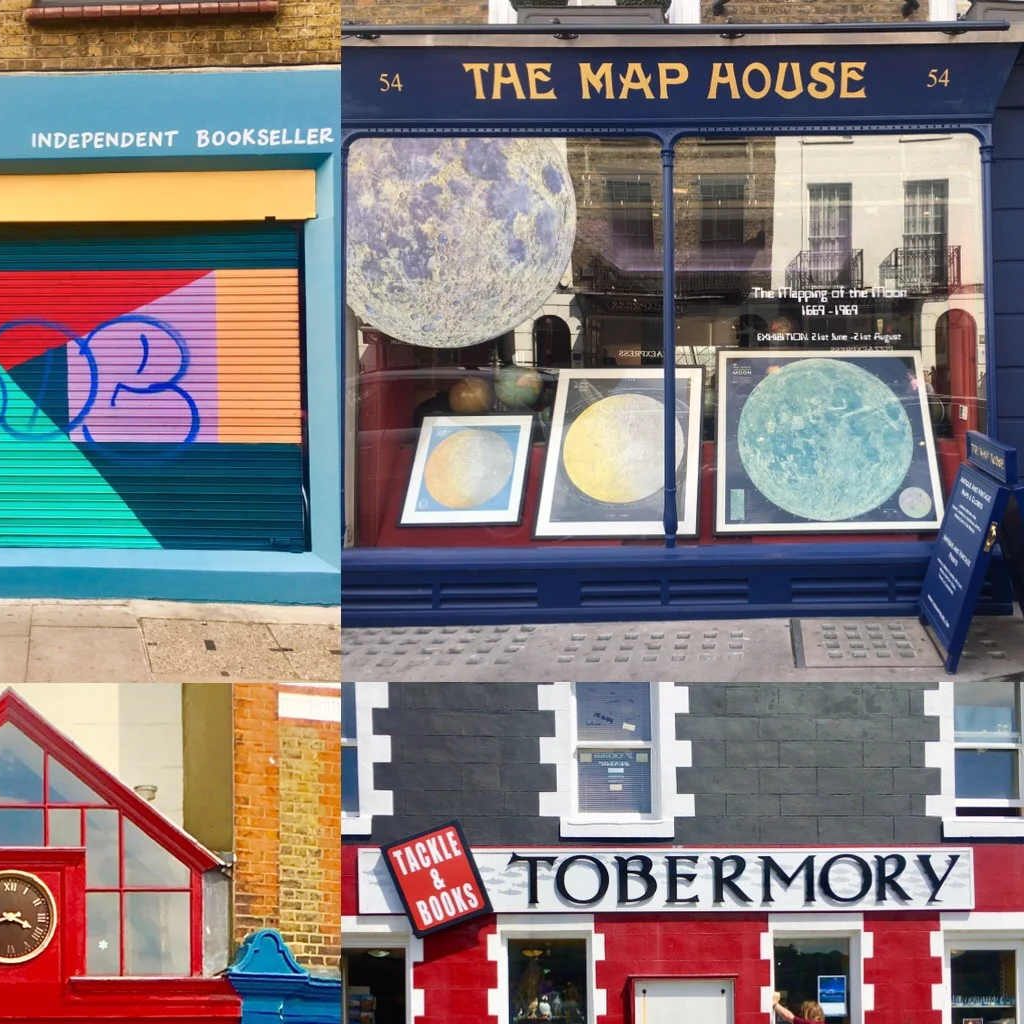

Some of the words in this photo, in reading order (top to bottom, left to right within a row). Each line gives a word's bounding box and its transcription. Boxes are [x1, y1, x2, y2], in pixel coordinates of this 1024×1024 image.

[379, 73, 403, 92] 54
[462, 62, 558, 100] THE
[578, 62, 689, 100] MAP
[707, 61, 867, 100] HOUSE
[927, 68, 950, 88] 54
[31, 130, 179, 149] INDEPENDENT
[196, 127, 335, 147] BOOKSELLER
[751, 287, 775, 299] The
[778, 287, 828, 303] Mapping
[831, 288, 845, 299] of
[849, 287, 869, 299] the
[871, 287, 908, 299] Moon
[801, 304, 825, 316] 1669
[811, 332, 829, 341] 21st
[831, 333, 848, 341] June
[873, 332, 902, 344] August
[392, 831, 462, 876] TACKLE
[429, 868, 446, 891] &
[507, 851, 961, 909] TOBERMORY
[415, 882, 479, 927] BOOKS
